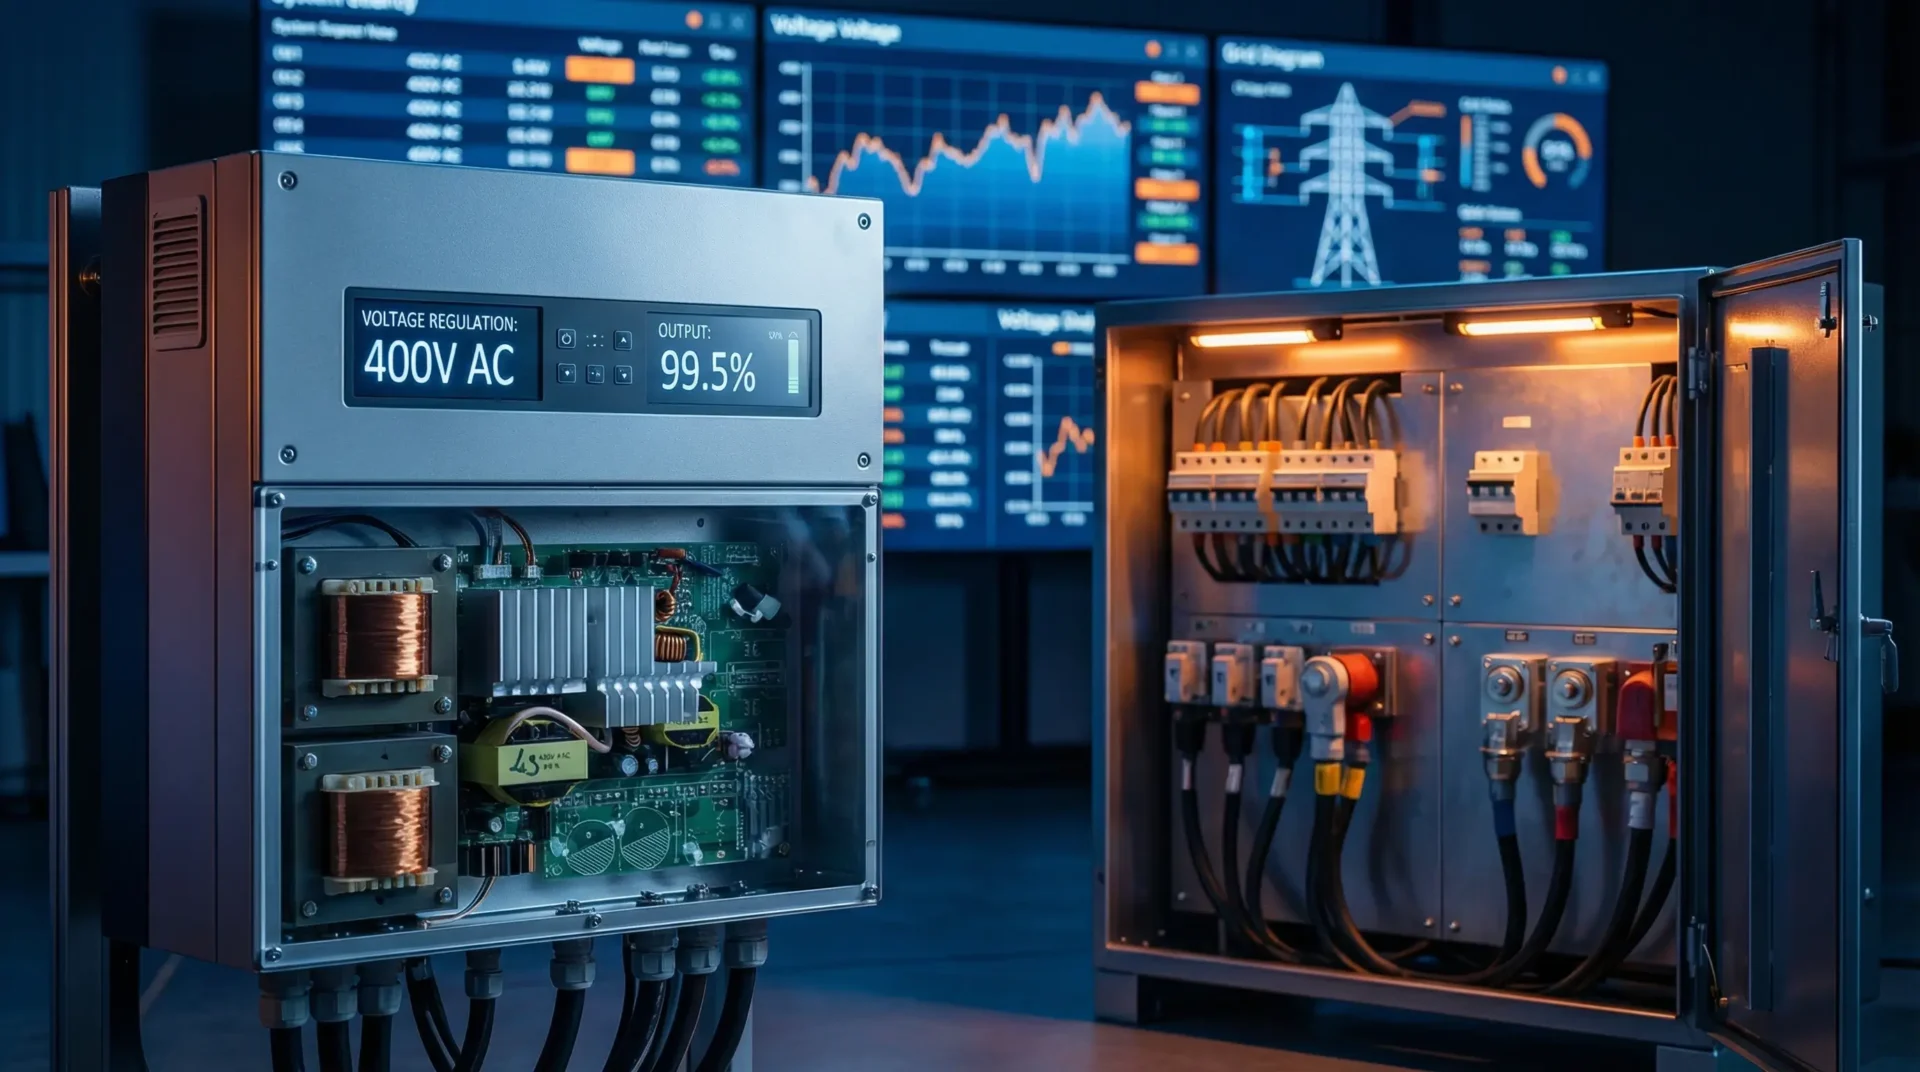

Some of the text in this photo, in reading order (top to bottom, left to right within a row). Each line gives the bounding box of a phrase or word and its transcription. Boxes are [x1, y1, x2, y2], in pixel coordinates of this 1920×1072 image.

[770, 14, 902, 46] Voltage Voltage
[1222, 42, 1325, 72] Grid Diagram
[362, 309, 518, 332] VOLTAGE REGULATION:
[658, 322, 711, 340] OUTPUT:
[997, 308, 1060, 335] Voltage
[364, 339, 514, 386] 400V AC
[660, 349, 756, 393] 99.5%
